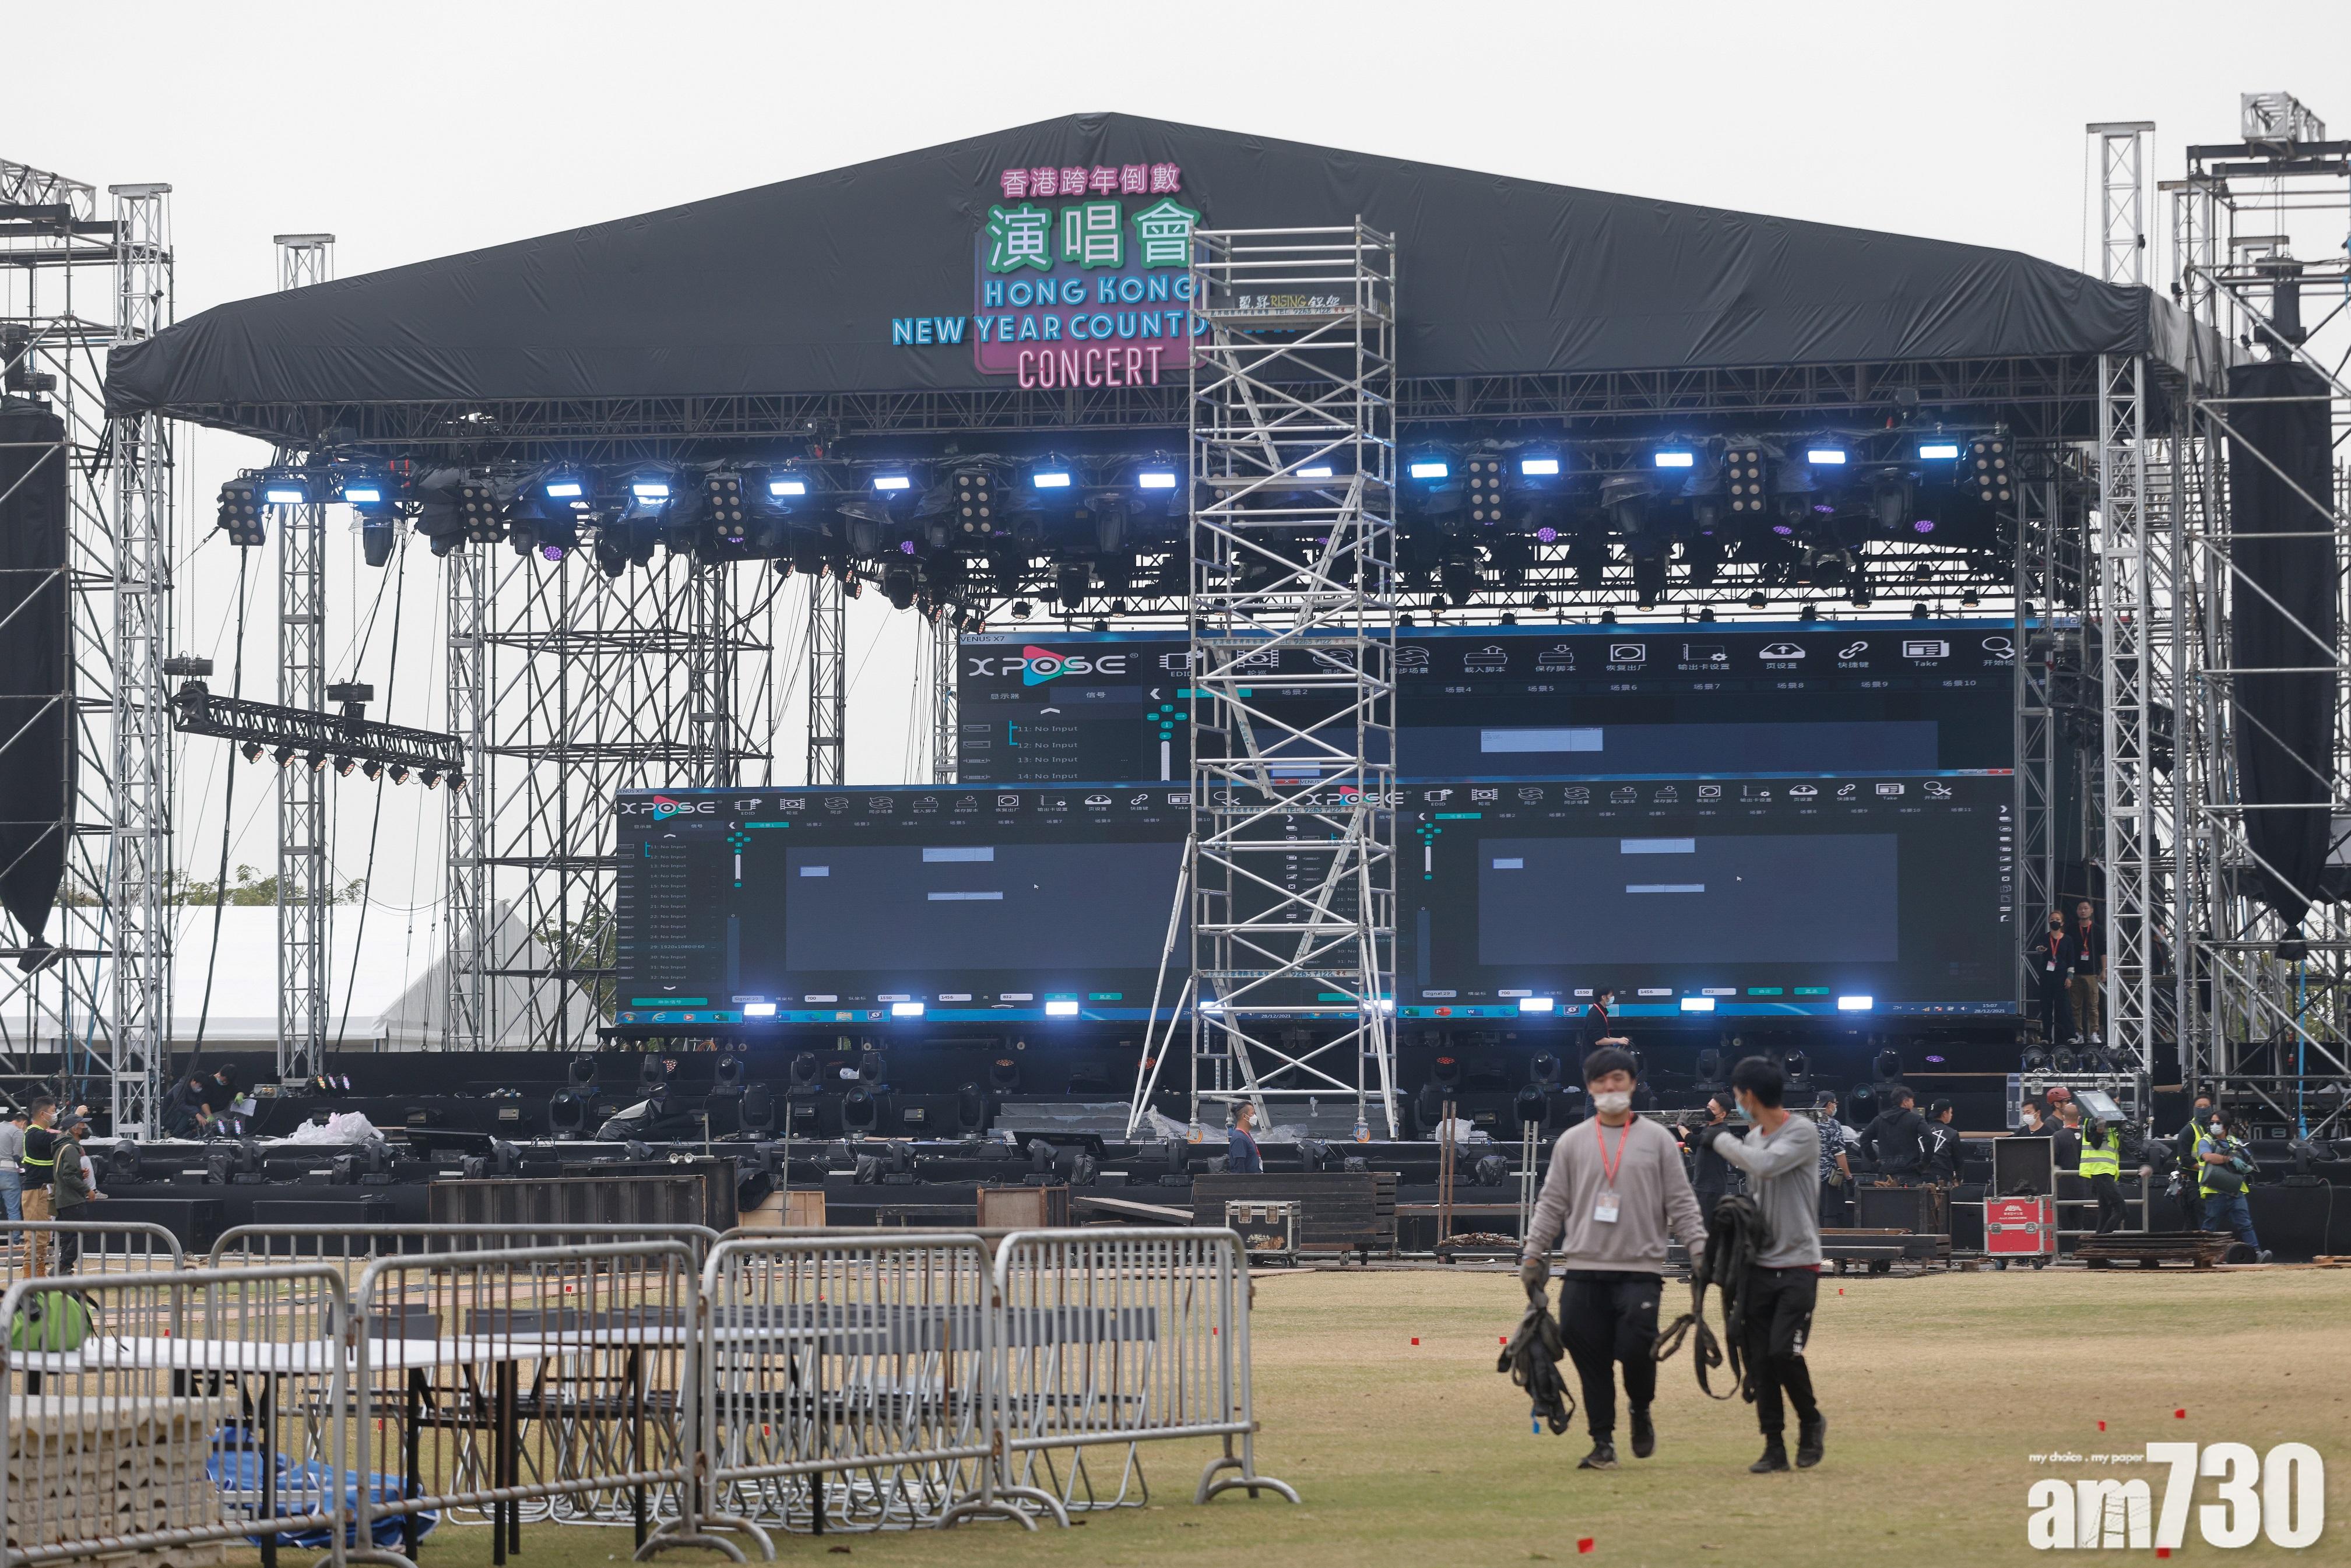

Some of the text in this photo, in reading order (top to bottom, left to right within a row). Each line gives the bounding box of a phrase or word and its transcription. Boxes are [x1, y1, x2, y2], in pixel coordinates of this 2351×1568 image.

[1001, 163, 1182, 199] 香港跨年倒數
[986, 198, 1200, 273] 演唱會
[984, 274, 1200, 307] HONG KONG
[1270, 295, 1307, 307] RISING
[892, 317, 965, 344] NEW
[975, 314, 1062, 342] YEAR
[1018, 346, 1164, 389] CONCERT
